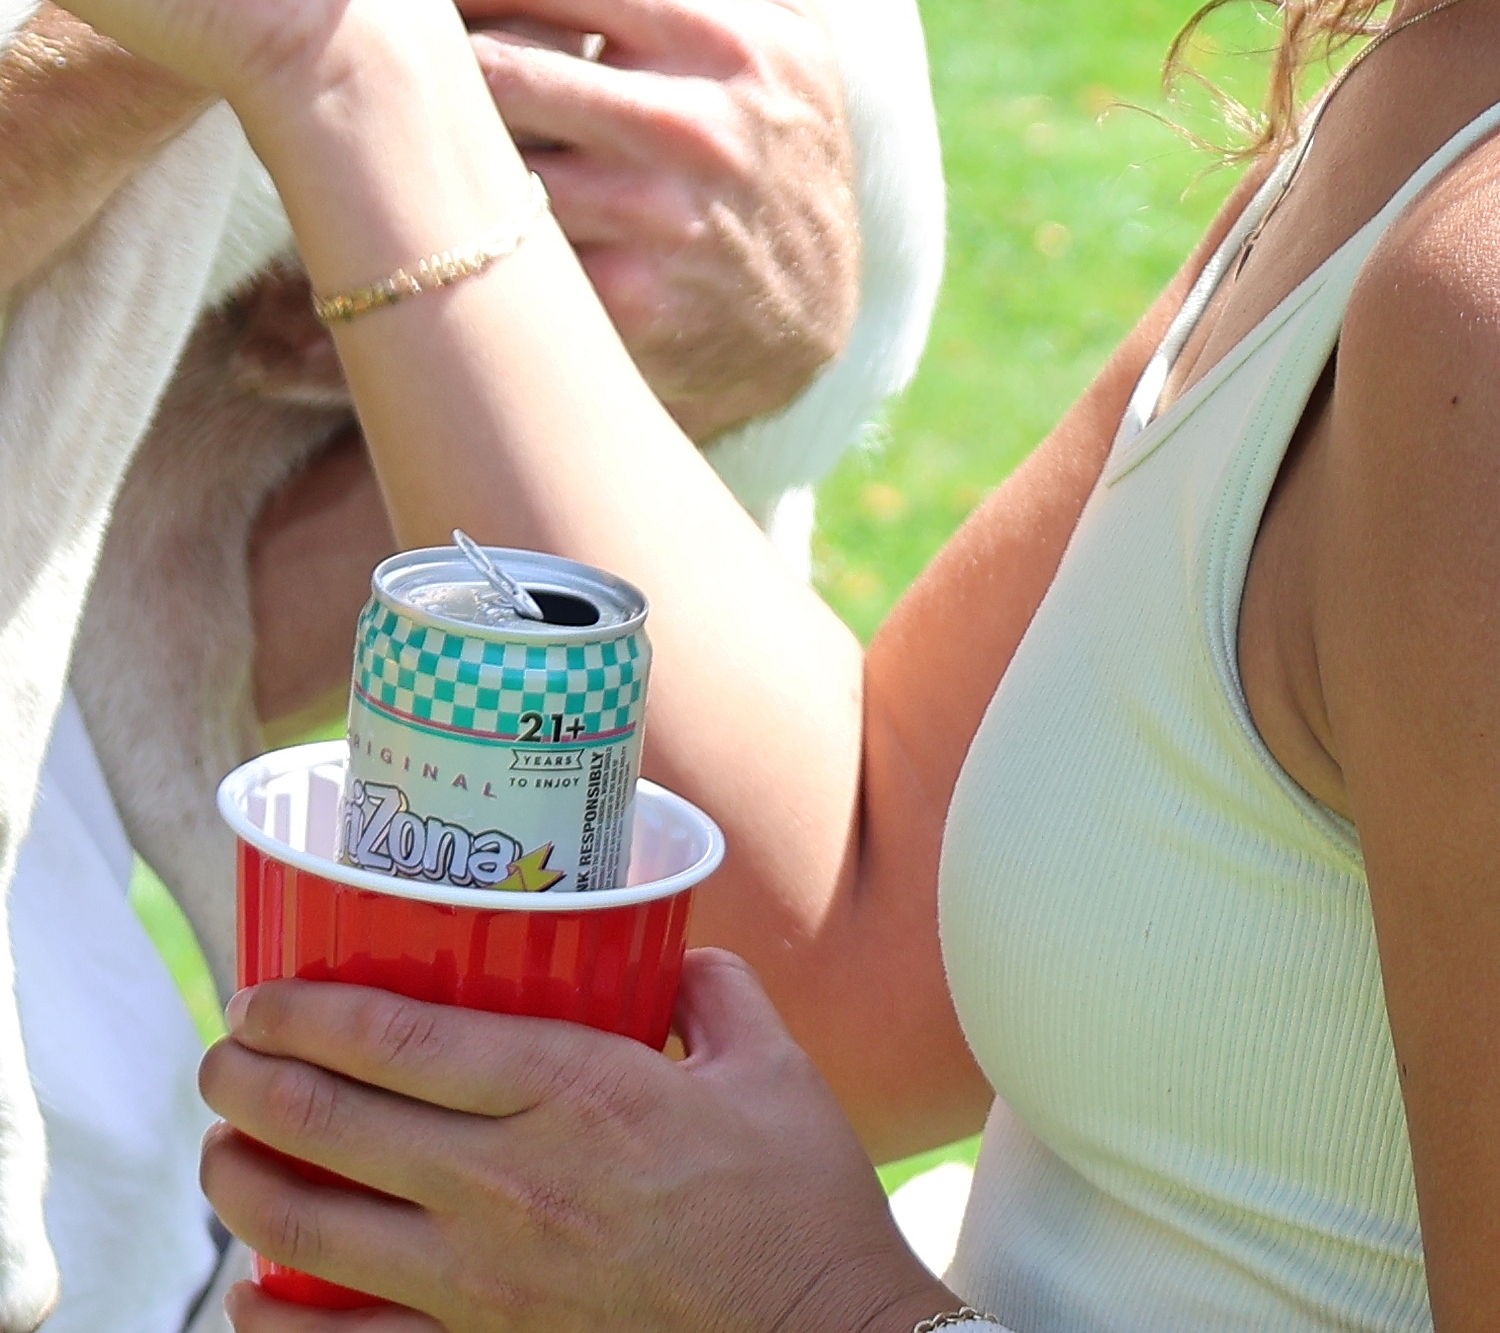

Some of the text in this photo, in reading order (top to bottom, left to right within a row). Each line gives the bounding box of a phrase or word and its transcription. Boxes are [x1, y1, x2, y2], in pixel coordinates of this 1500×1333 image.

[516, 711, 586, 743] 21+
[348, 728, 498, 799] RIGINAL
[523, 755, 573, 766] YEARS
[509, 776, 580, 789] TO ENJOY
[578, 751, 605, 867] RESPONSIBLY
